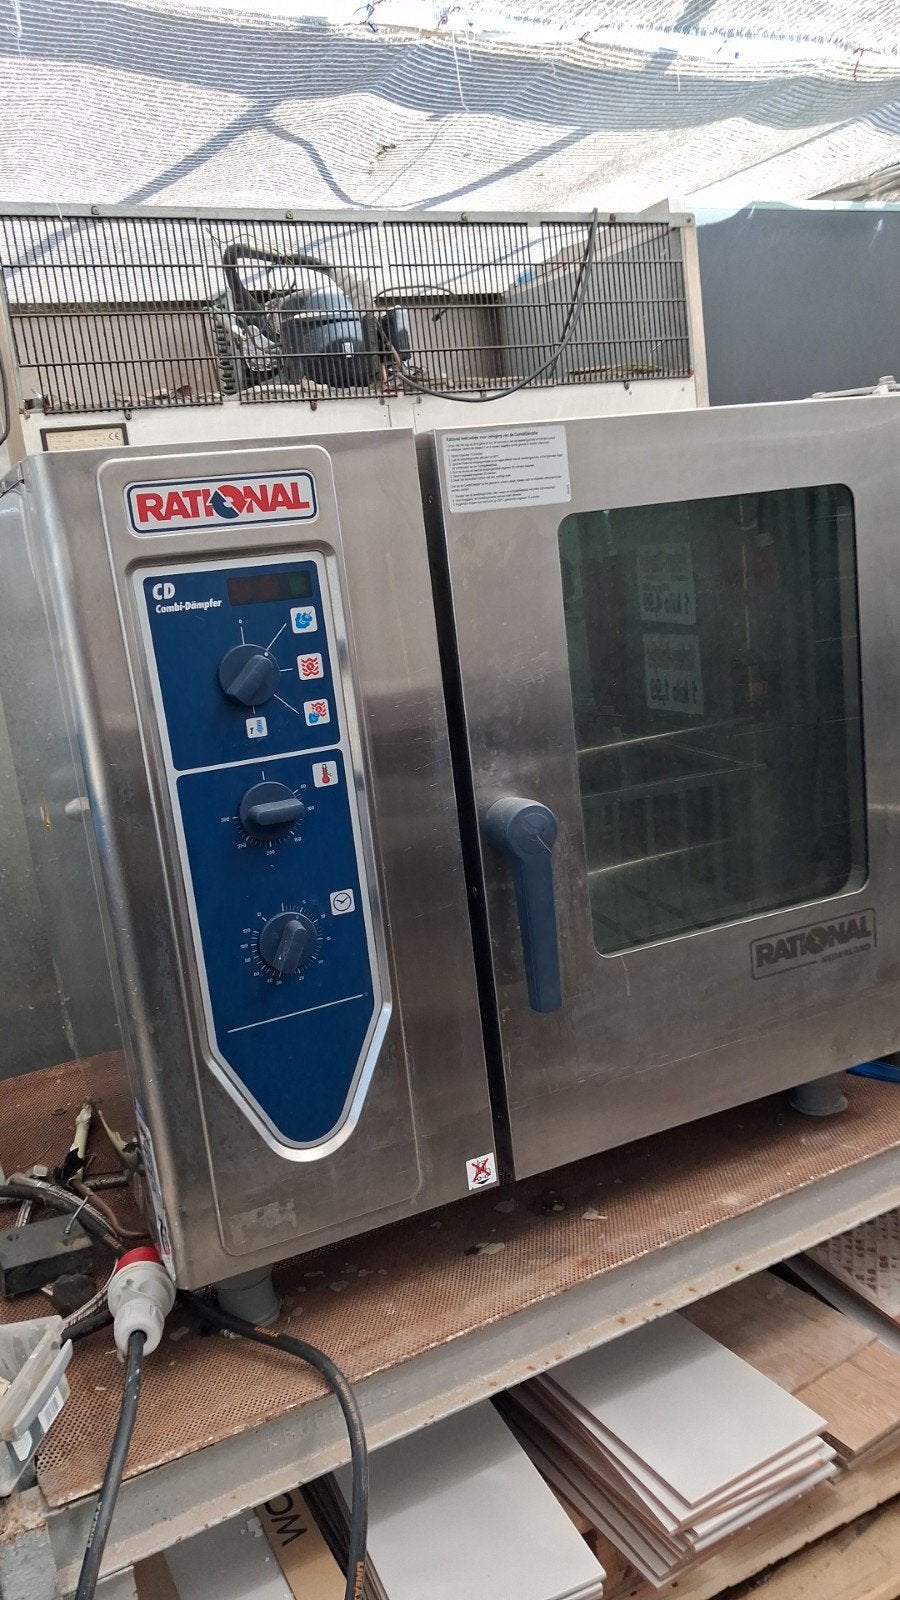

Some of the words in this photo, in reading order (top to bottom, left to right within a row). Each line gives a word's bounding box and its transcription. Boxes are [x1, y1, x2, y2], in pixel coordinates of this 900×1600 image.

[136, 482, 310, 523] RATIONAL
[152, 582, 176, 600] CD
[155, 599, 222, 614] Combi-Dämpfer
[756, 916, 872, 968] RATIONAL
